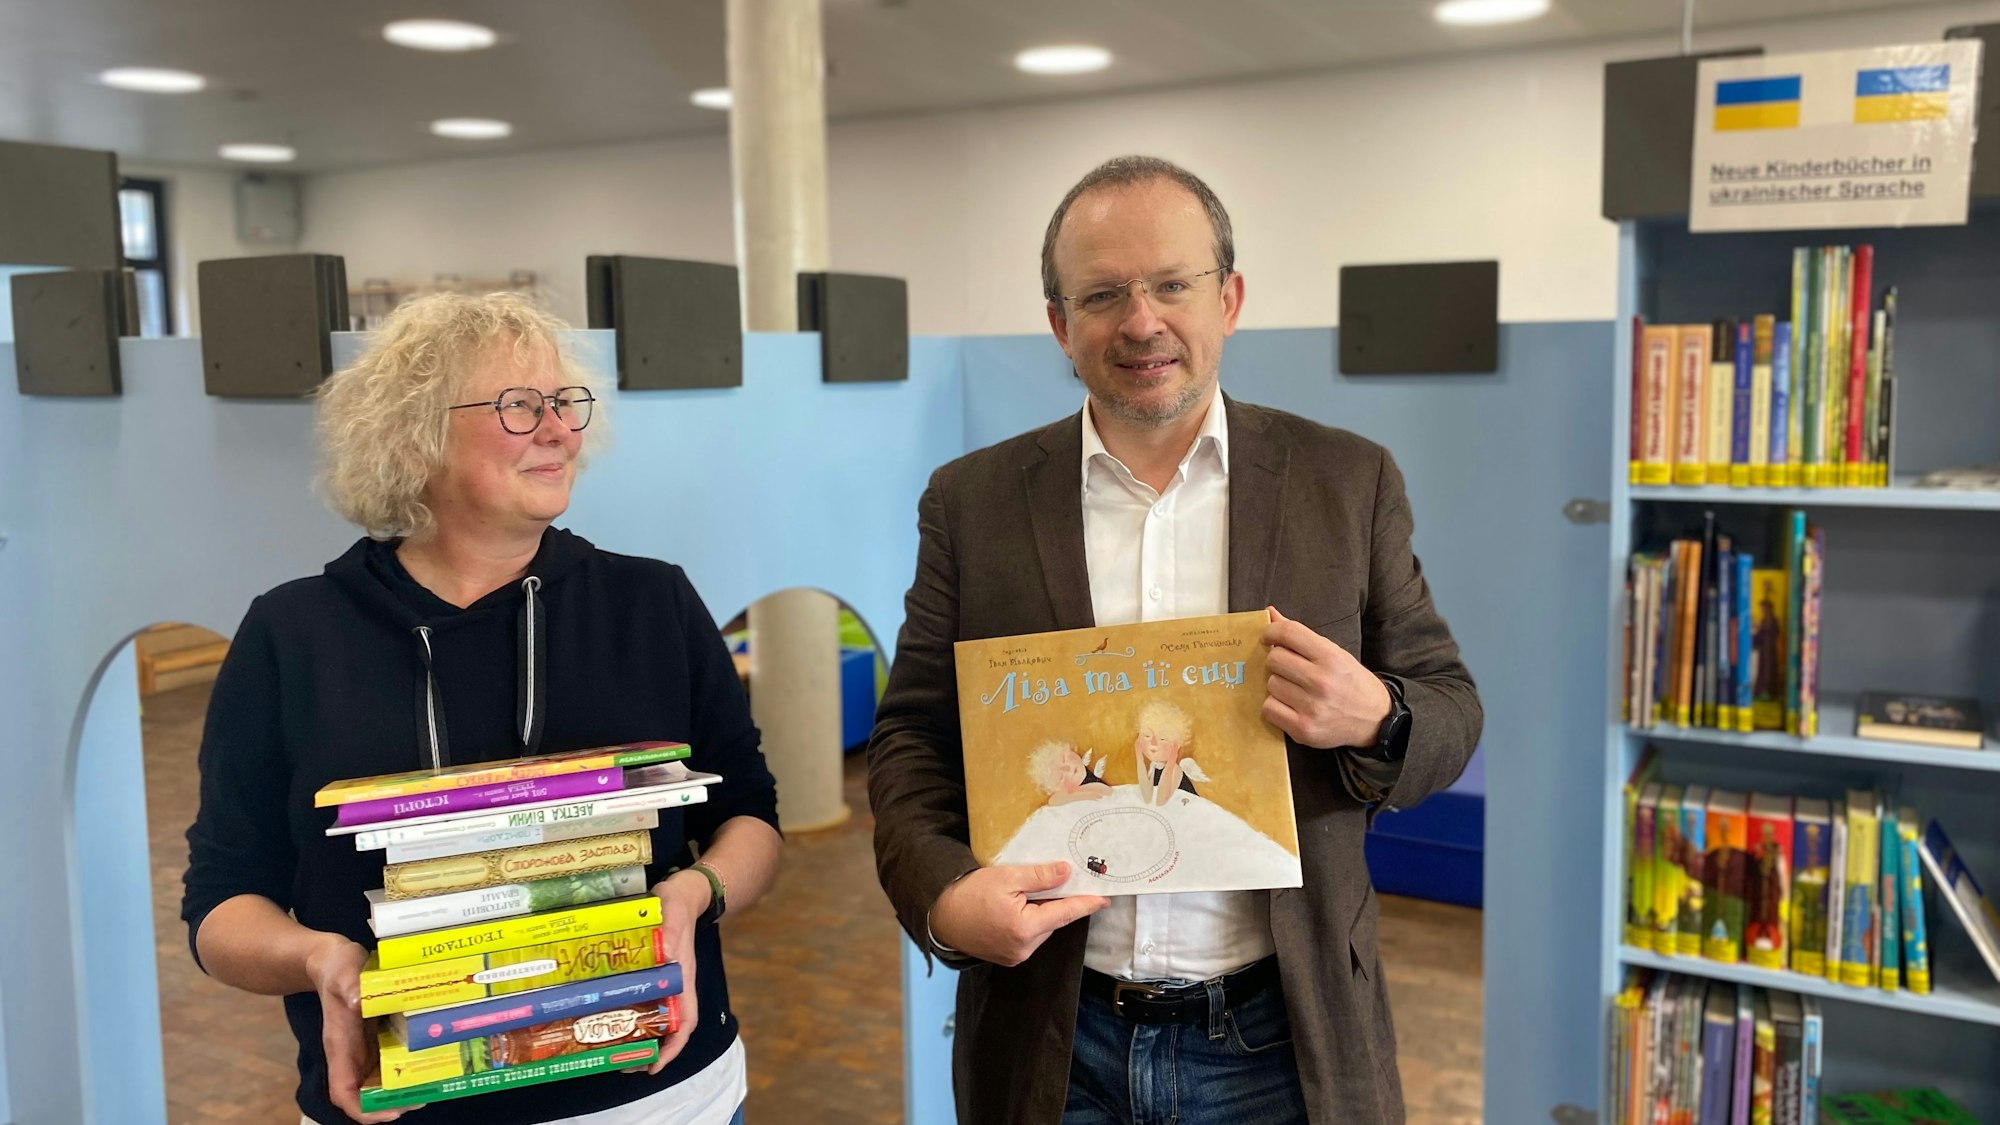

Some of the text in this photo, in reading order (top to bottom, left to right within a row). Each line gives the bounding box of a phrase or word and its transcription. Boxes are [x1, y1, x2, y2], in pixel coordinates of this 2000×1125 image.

[1710, 153, 1932, 179] Neue Kinderbücher in
[1709, 178, 1926, 203] ukrainischer Sprache
[508, 810, 546, 827] ВІЙНИ
[552, 803, 594, 820] АБЕТКА
[421, 929, 504, 958] ГЕОГРАФІЇ
